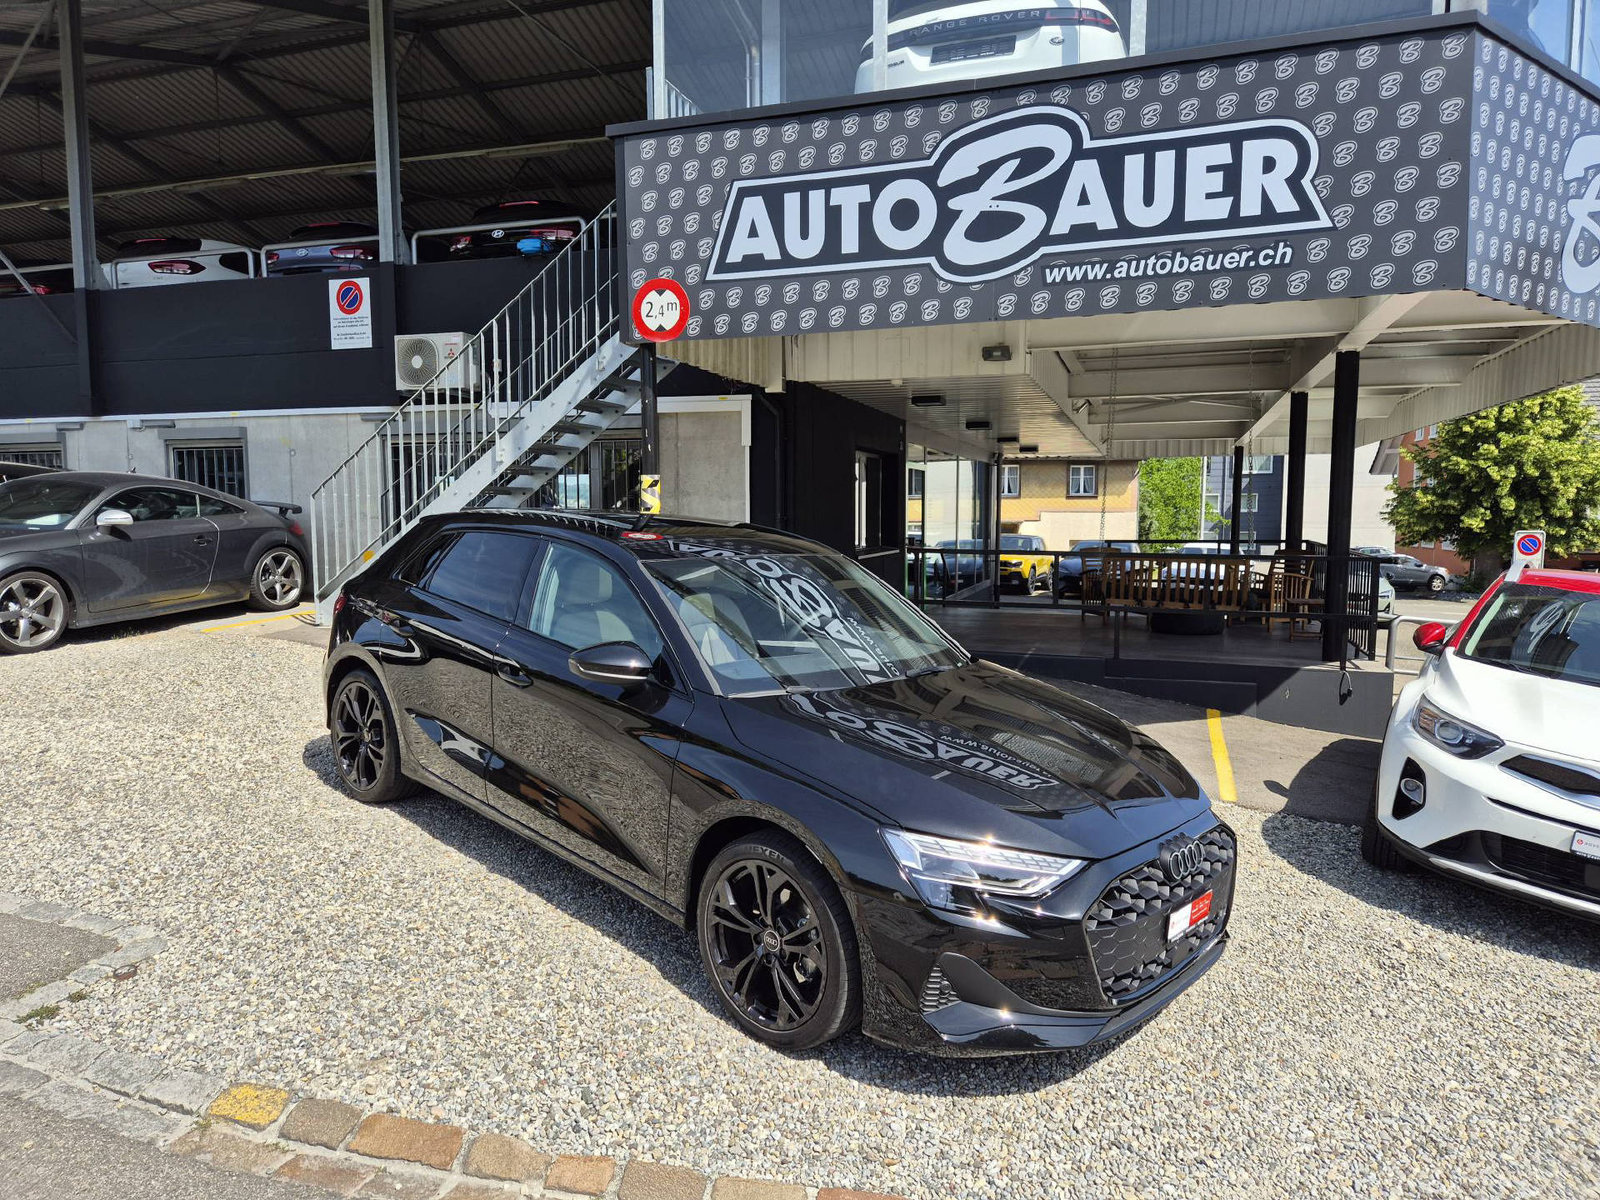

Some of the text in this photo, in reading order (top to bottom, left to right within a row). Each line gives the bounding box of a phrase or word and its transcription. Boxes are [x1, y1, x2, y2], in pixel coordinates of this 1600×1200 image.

[909, 11, 1040, 37] RANGE ROVER
[1045, 242, 1292, 283] www.autobauer.ch
